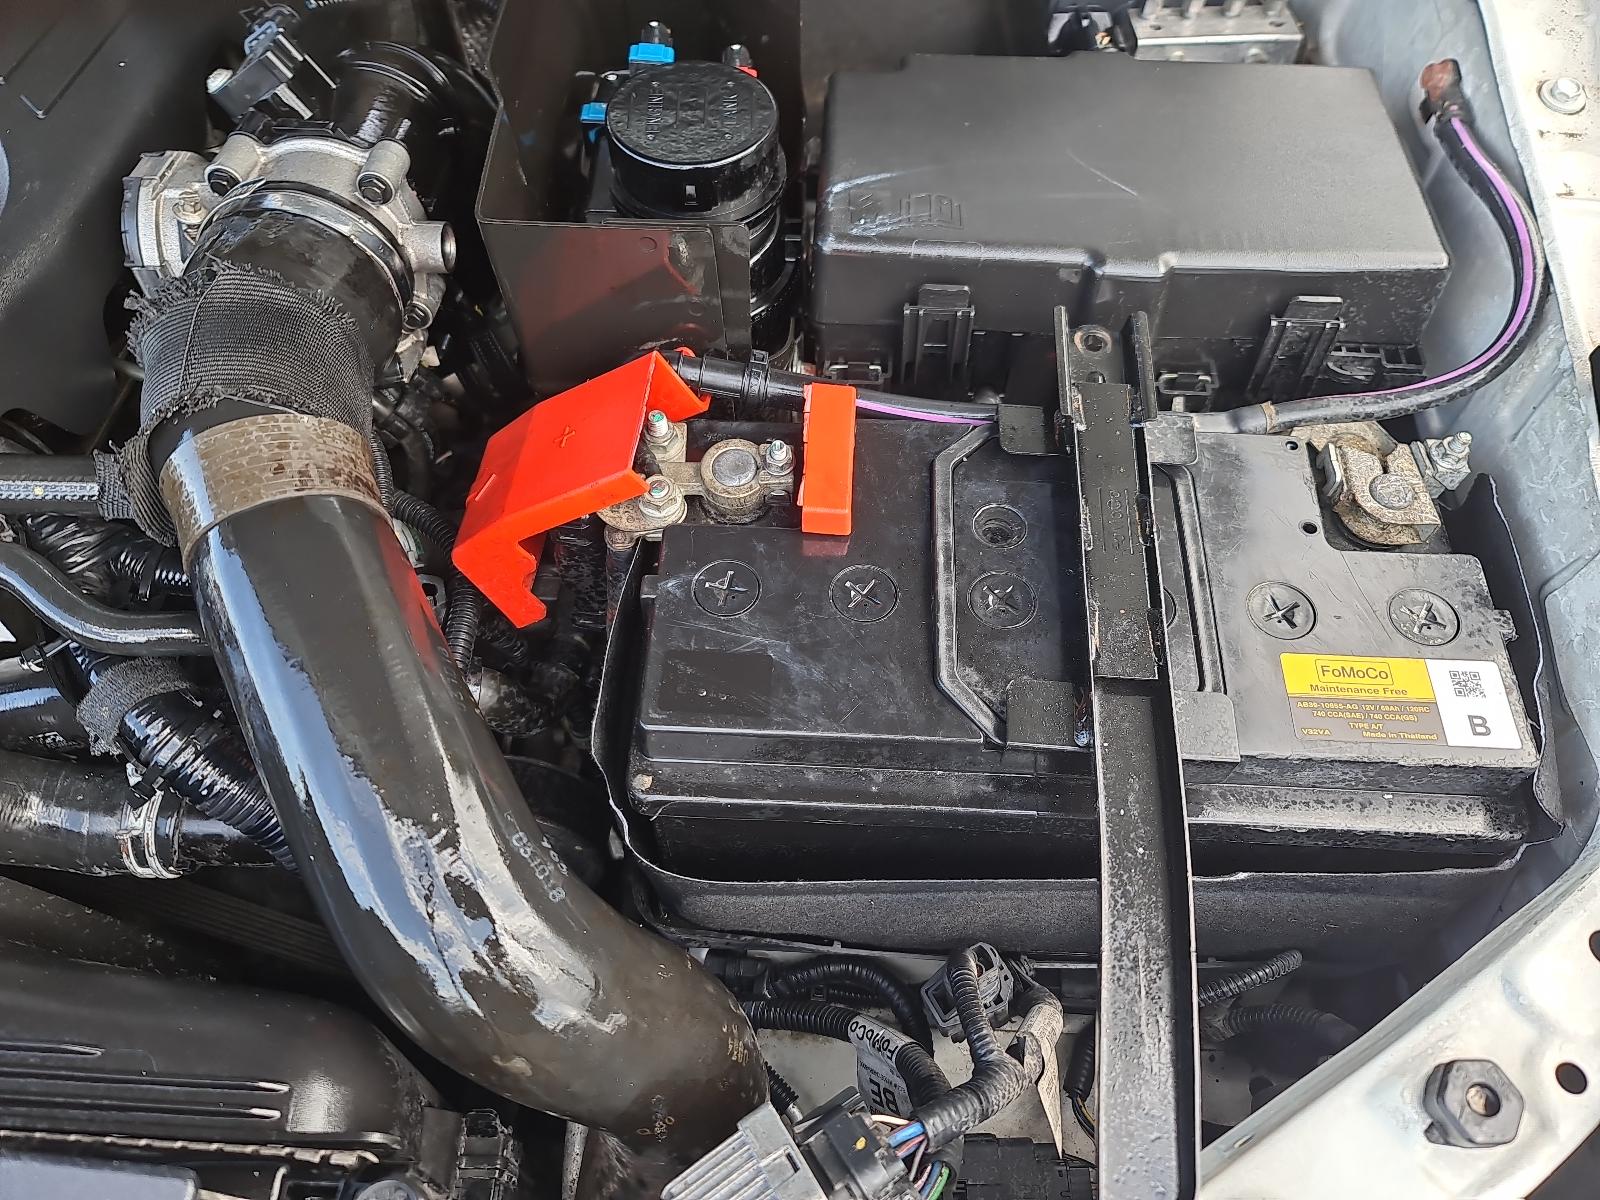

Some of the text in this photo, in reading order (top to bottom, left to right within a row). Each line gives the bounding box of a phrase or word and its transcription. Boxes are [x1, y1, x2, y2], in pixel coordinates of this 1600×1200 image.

[1320, 664, 1389, 680] FoMoCo
[1310, 684, 1408, 696] Maintenance Free
[1327, 711, 1365, 720] CCA(SAE)
[1468, 715, 1491, 736] B
[1399, 732, 1438, 740] Thailand
[850, 1019, 899, 1060] FoMoCo
